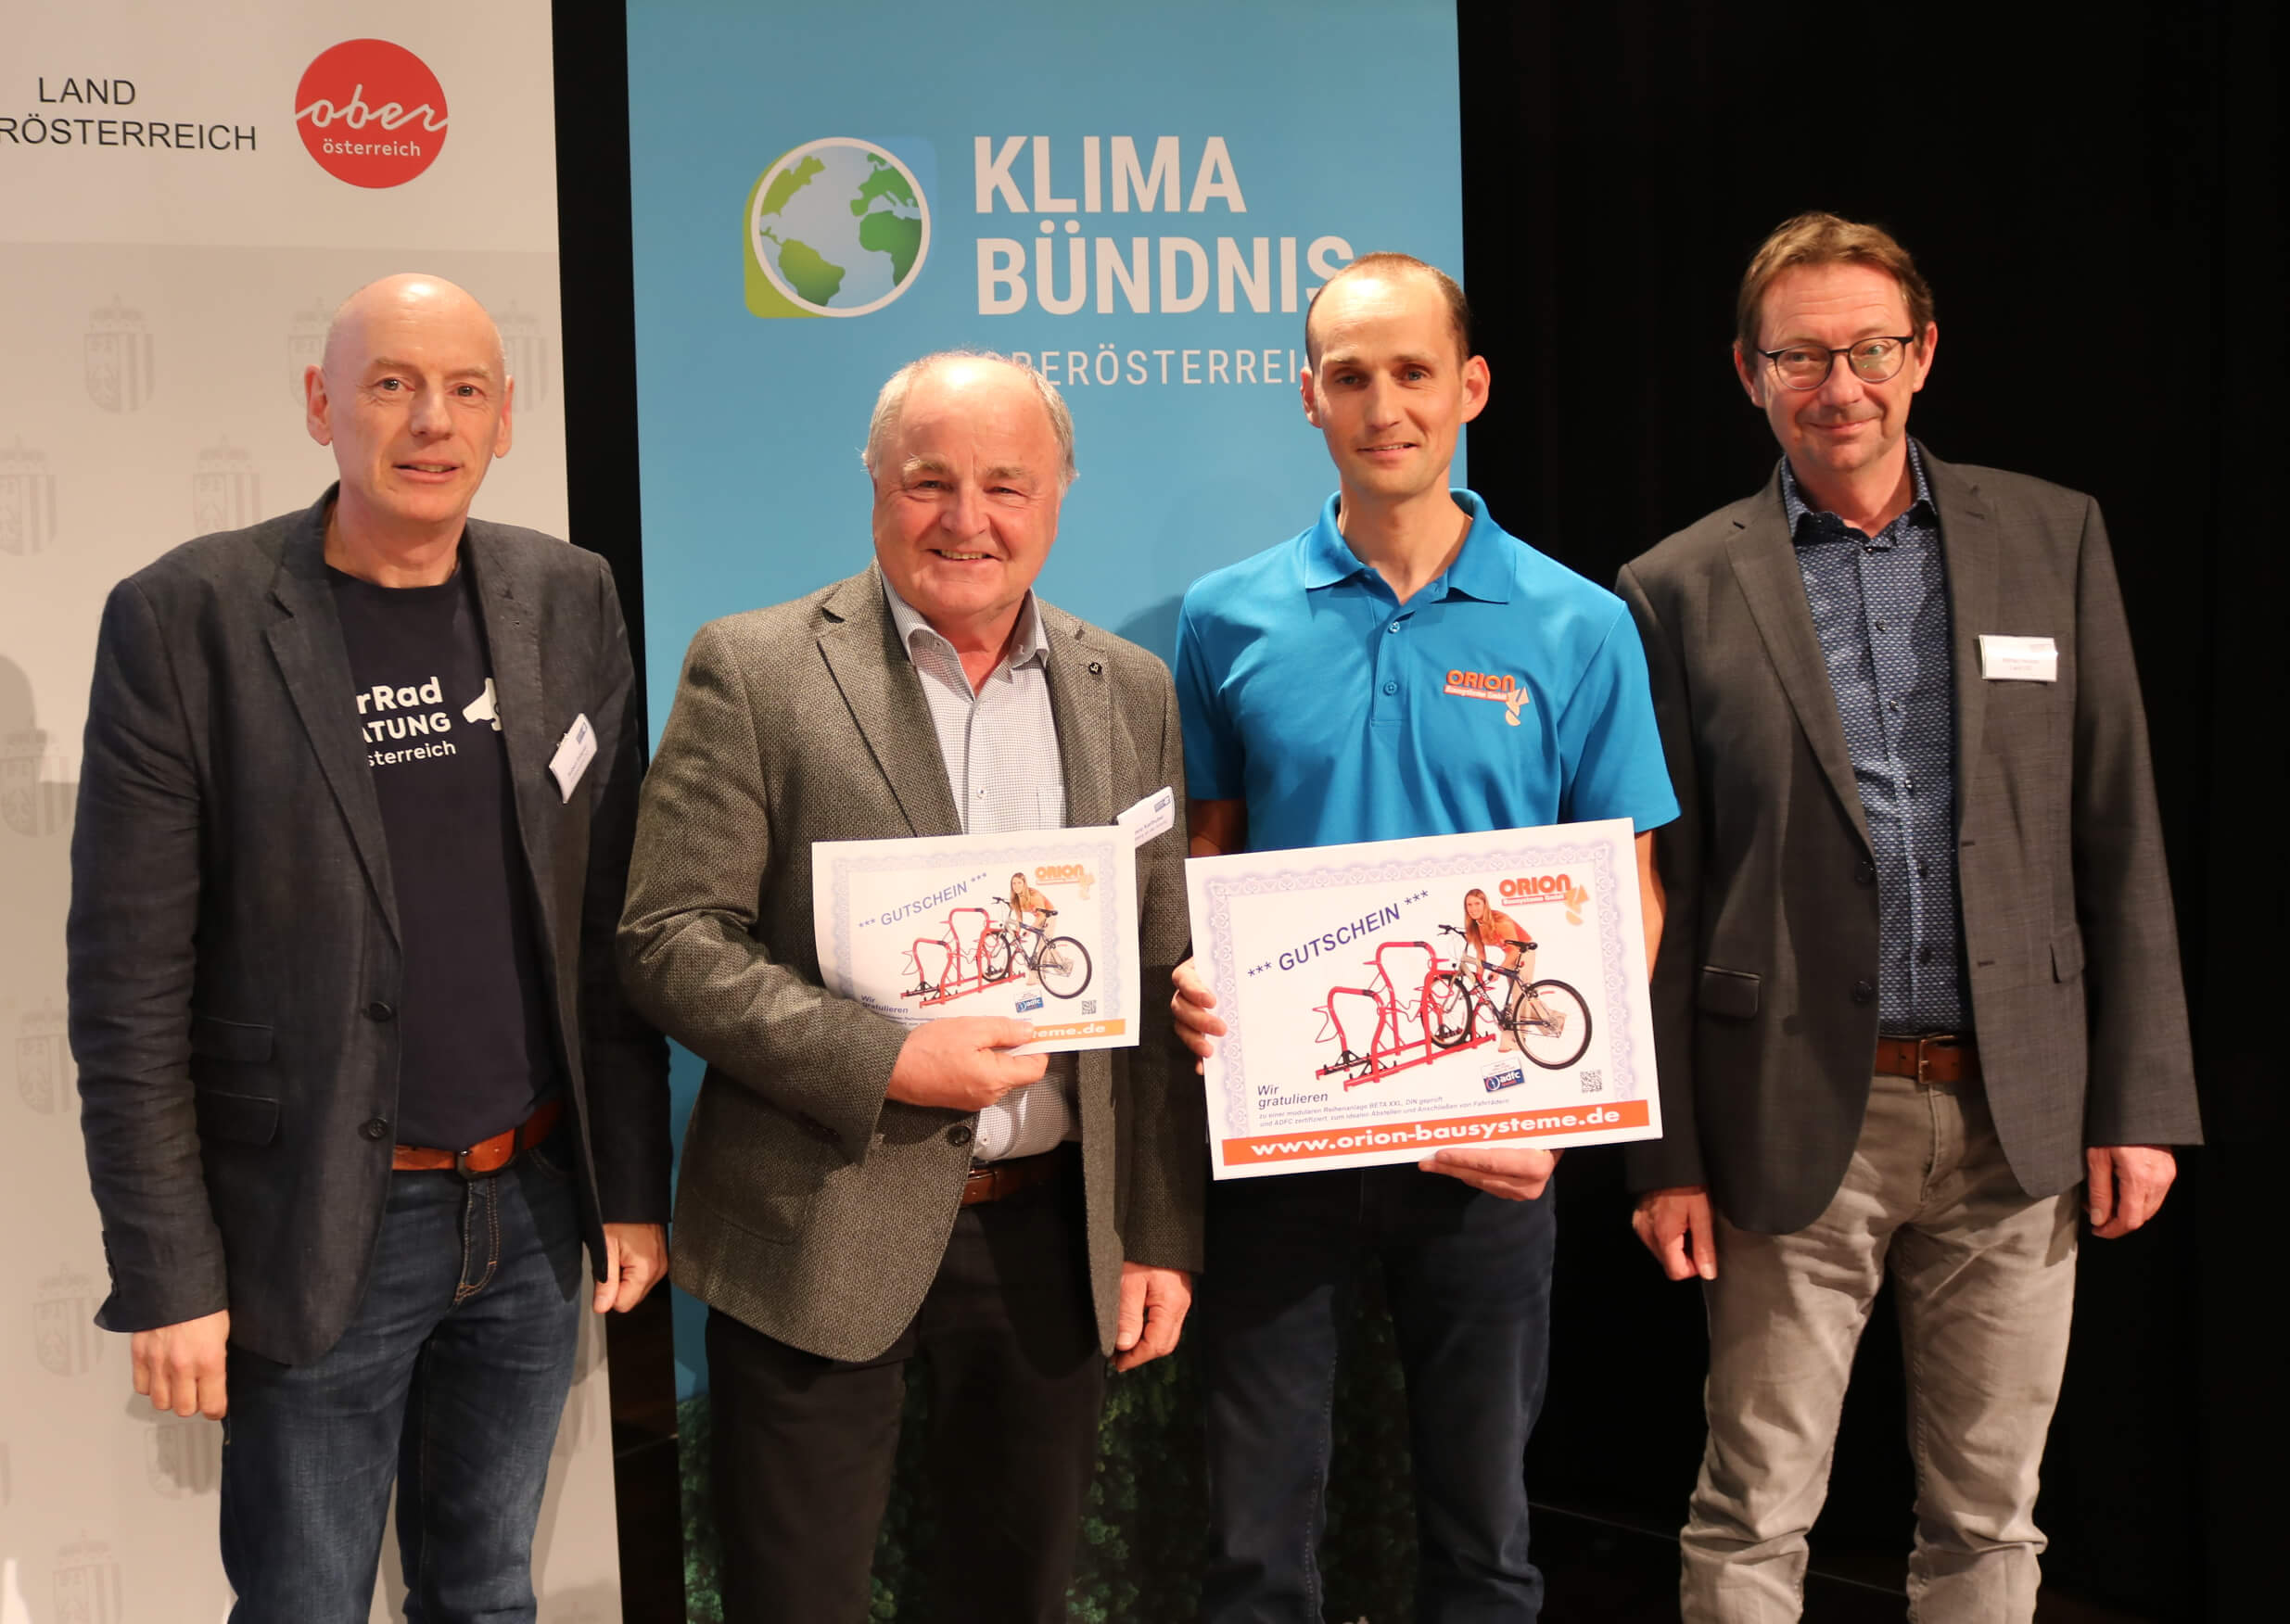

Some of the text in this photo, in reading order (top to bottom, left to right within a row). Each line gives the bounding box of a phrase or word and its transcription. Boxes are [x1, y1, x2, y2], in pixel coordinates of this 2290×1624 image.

[38, 77, 136, 106] LAND
[296, 83, 449, 132] ober
[0, 114, 256, 151] RÖSTERREICH
[323, 138, 421, 157] österreich
[973, 135, 1247, 213] KLIMA
[976, 219, 1355, 315] BÜNDNIS
[1446, 669, 1515, 692] ORION
[880, 881, 968, 926] GUTSCHEIN
[1498, 873, 1571, 897] ORION
[1278, 902, 1401, 971] GUTSCHEIN
[1257, 1085, 1279, 1097] Wir
[1258, 1093, 1329, 1110] gratulieren
[1251, 1109, 1620, 1157] www.orion-bausysteme.de
